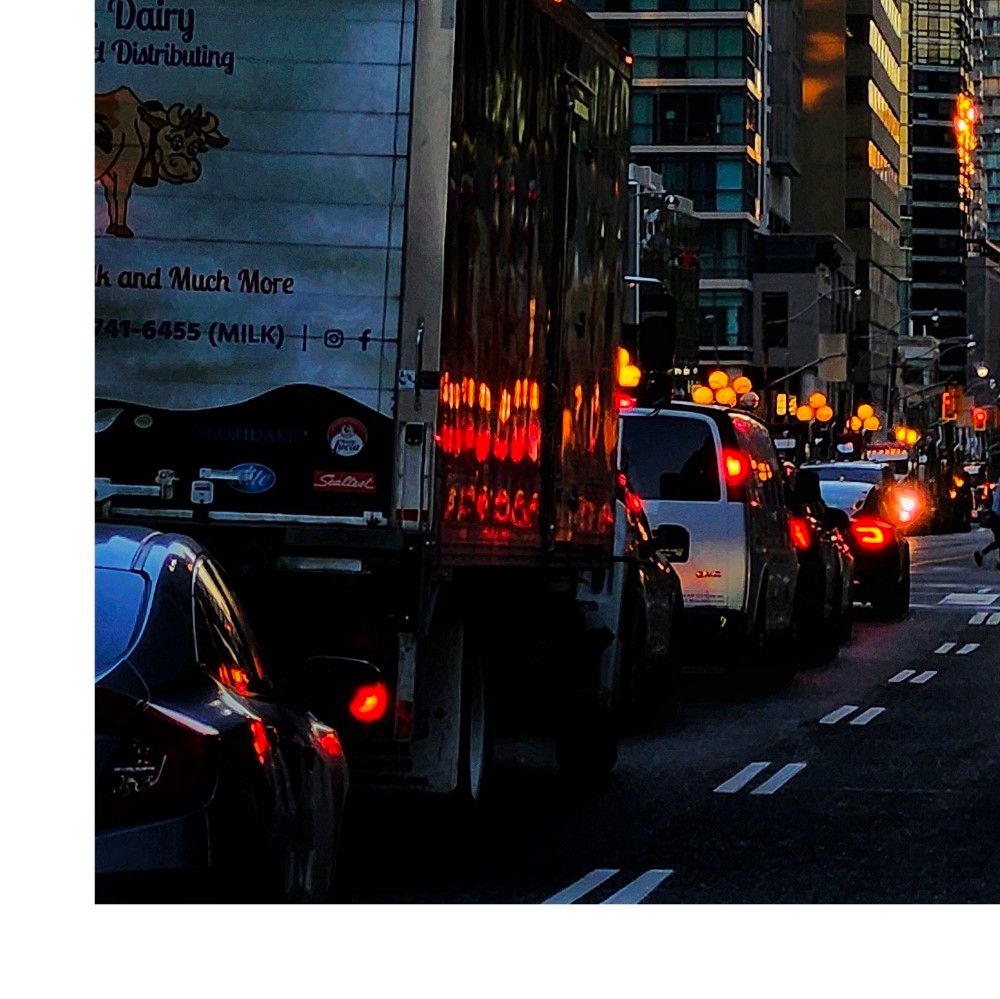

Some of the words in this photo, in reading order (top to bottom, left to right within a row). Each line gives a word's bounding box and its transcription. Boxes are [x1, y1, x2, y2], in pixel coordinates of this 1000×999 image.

[111, 39, 234, 75] Distributing
[118, 267, 162, 290] and
[169, 266, 231, 292] Much
[237, 269, 294, 294] More
[208, 322, 285, 349] (MILK)
